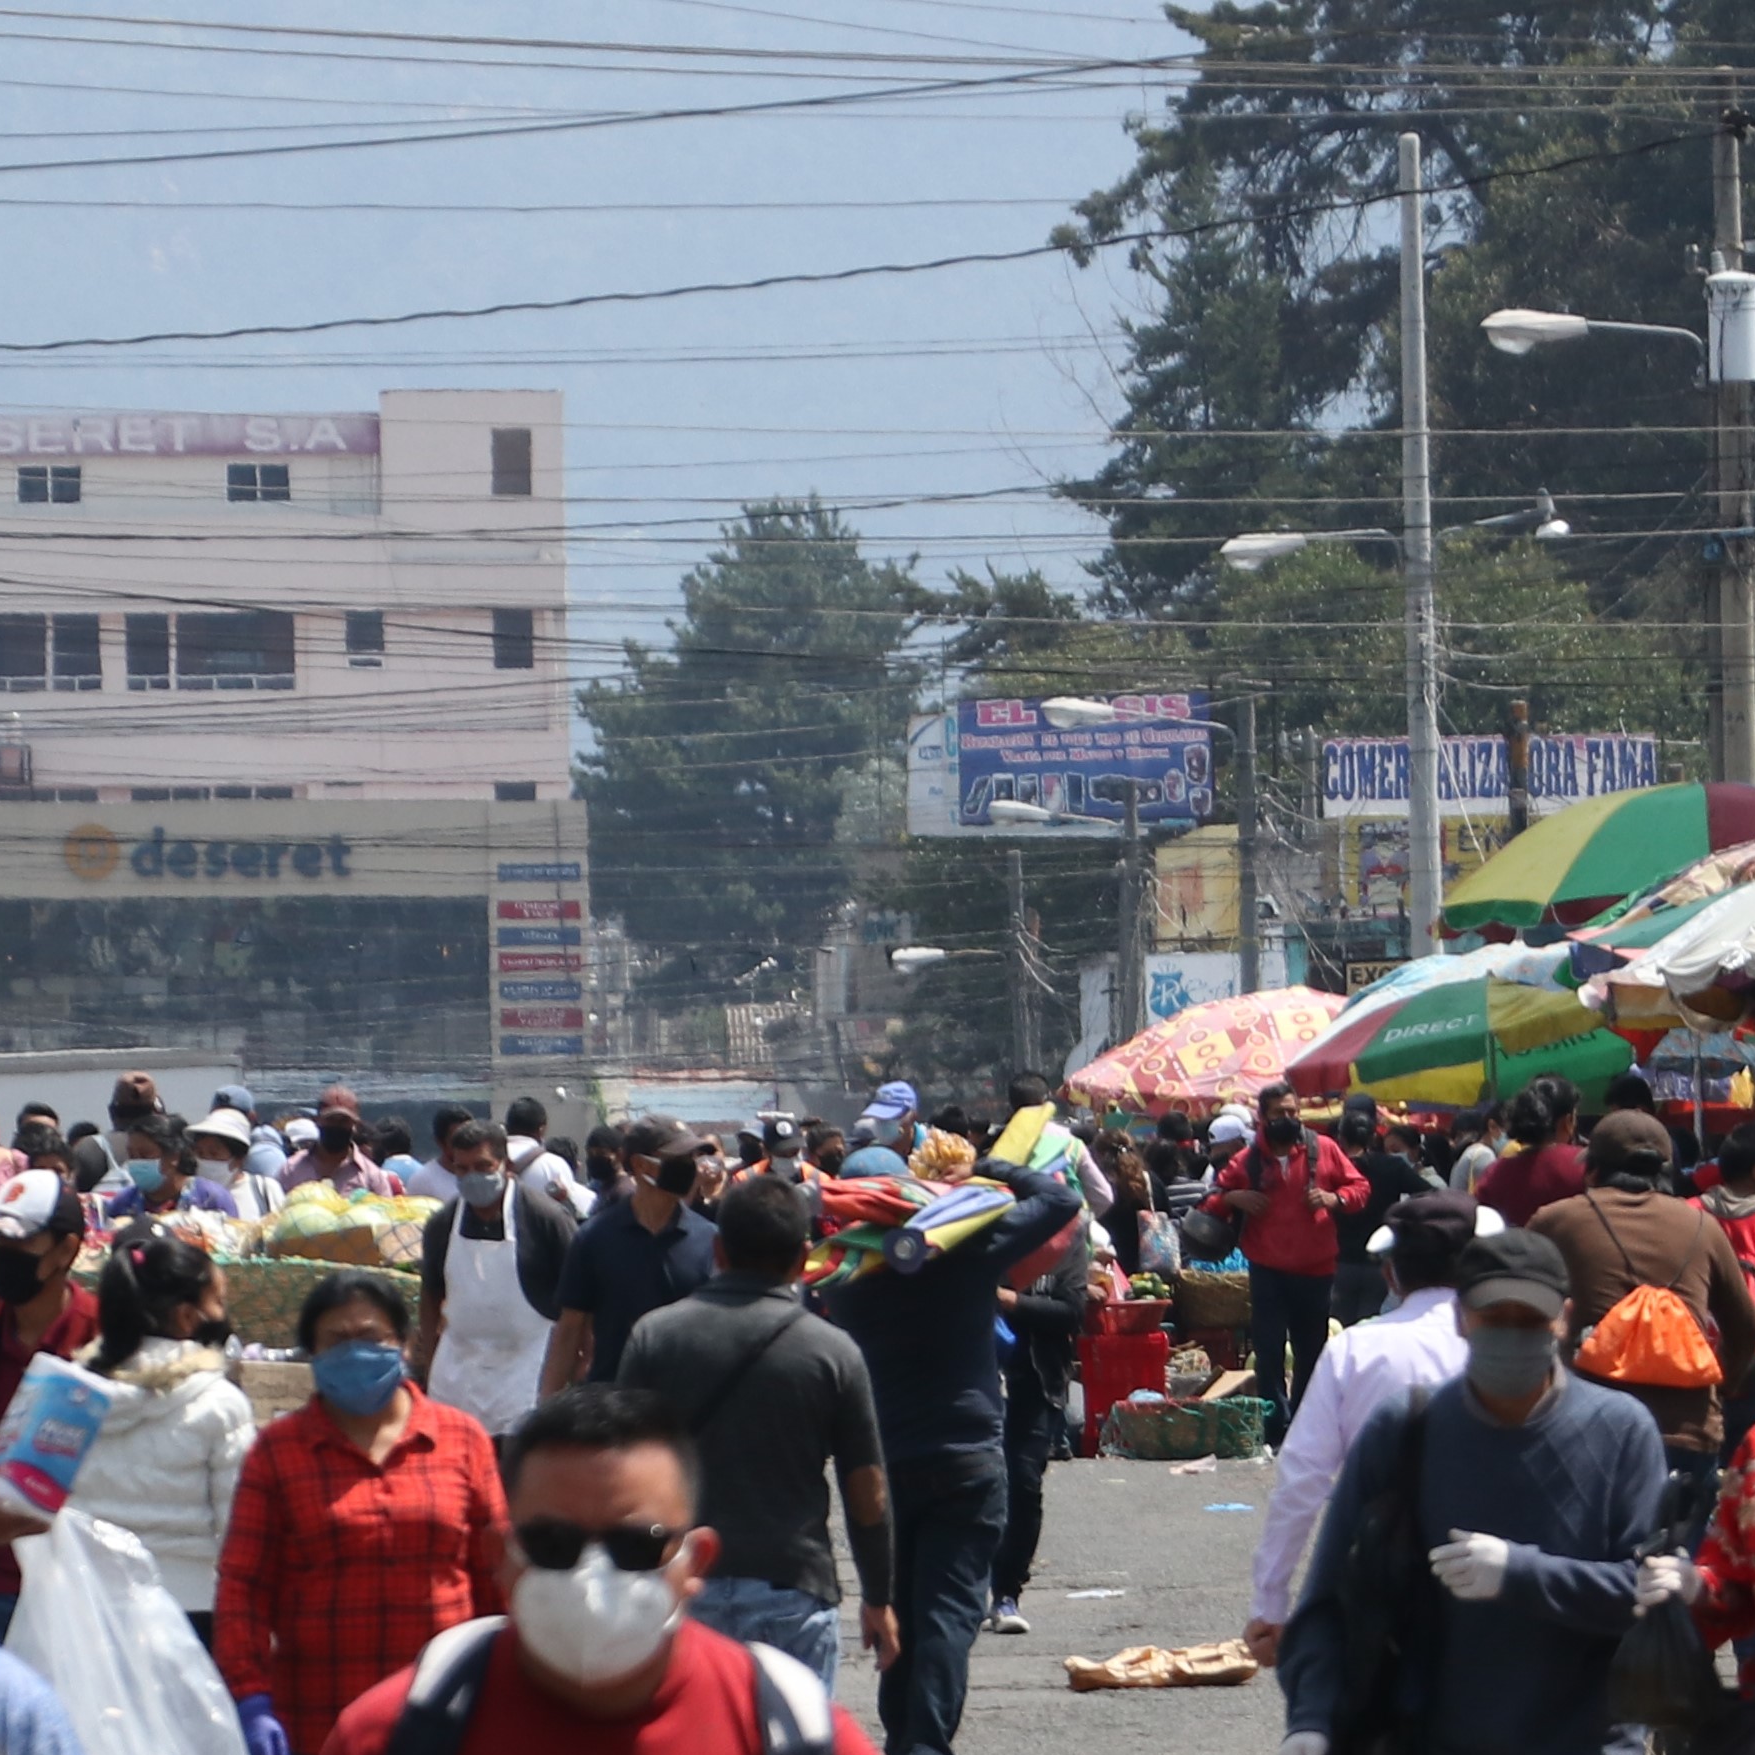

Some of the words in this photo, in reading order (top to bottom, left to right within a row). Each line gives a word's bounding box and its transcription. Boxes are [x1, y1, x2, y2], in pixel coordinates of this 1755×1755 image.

[976, 699, 1037, 727] EL
[1584, 736, 1658, 797] FAMA
[131, 825, 351, 878] deseret
[1383, 1013, 1479, 1044] DIRECT
